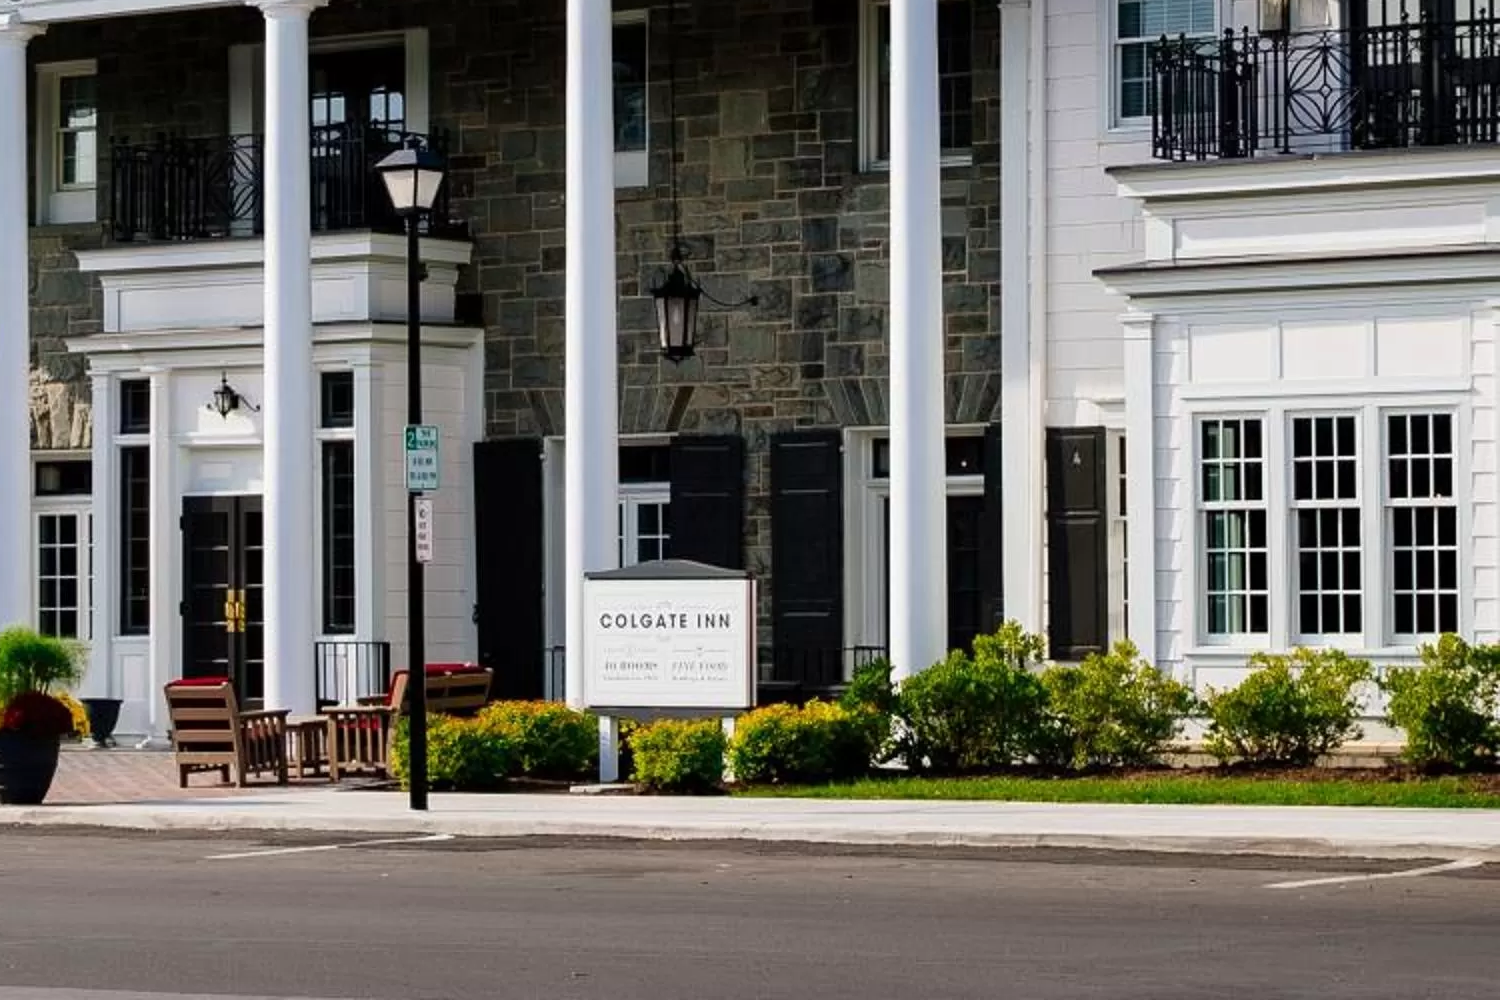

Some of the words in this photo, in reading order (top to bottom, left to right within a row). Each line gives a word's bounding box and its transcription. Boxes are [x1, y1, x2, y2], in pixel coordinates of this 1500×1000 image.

[407, 431, 415, 449] 2
[599, 613, 688, 629] COLGATE
[697, 613, 731, 629] INN
